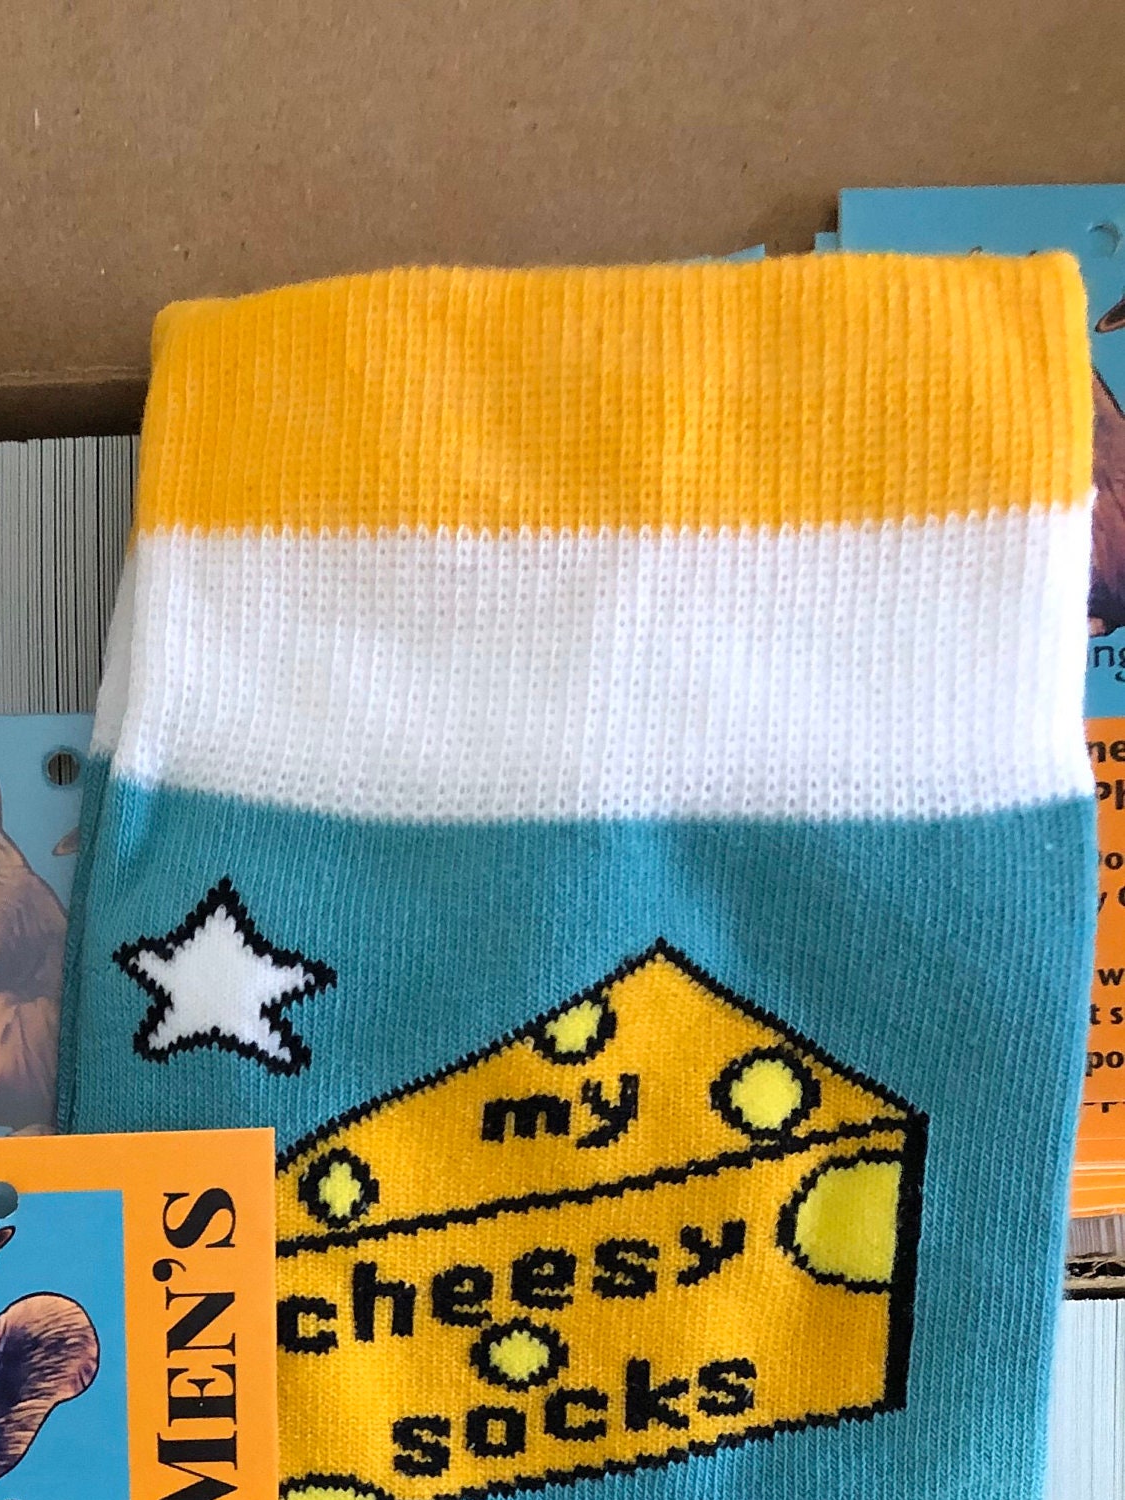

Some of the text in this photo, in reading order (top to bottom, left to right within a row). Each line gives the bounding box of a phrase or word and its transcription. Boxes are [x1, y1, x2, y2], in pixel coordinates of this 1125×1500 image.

[481, 1072, 640, 1149] my
[277, 1218, 746, 1355] cheesy
[391, 1357, 757, 1477] socks
